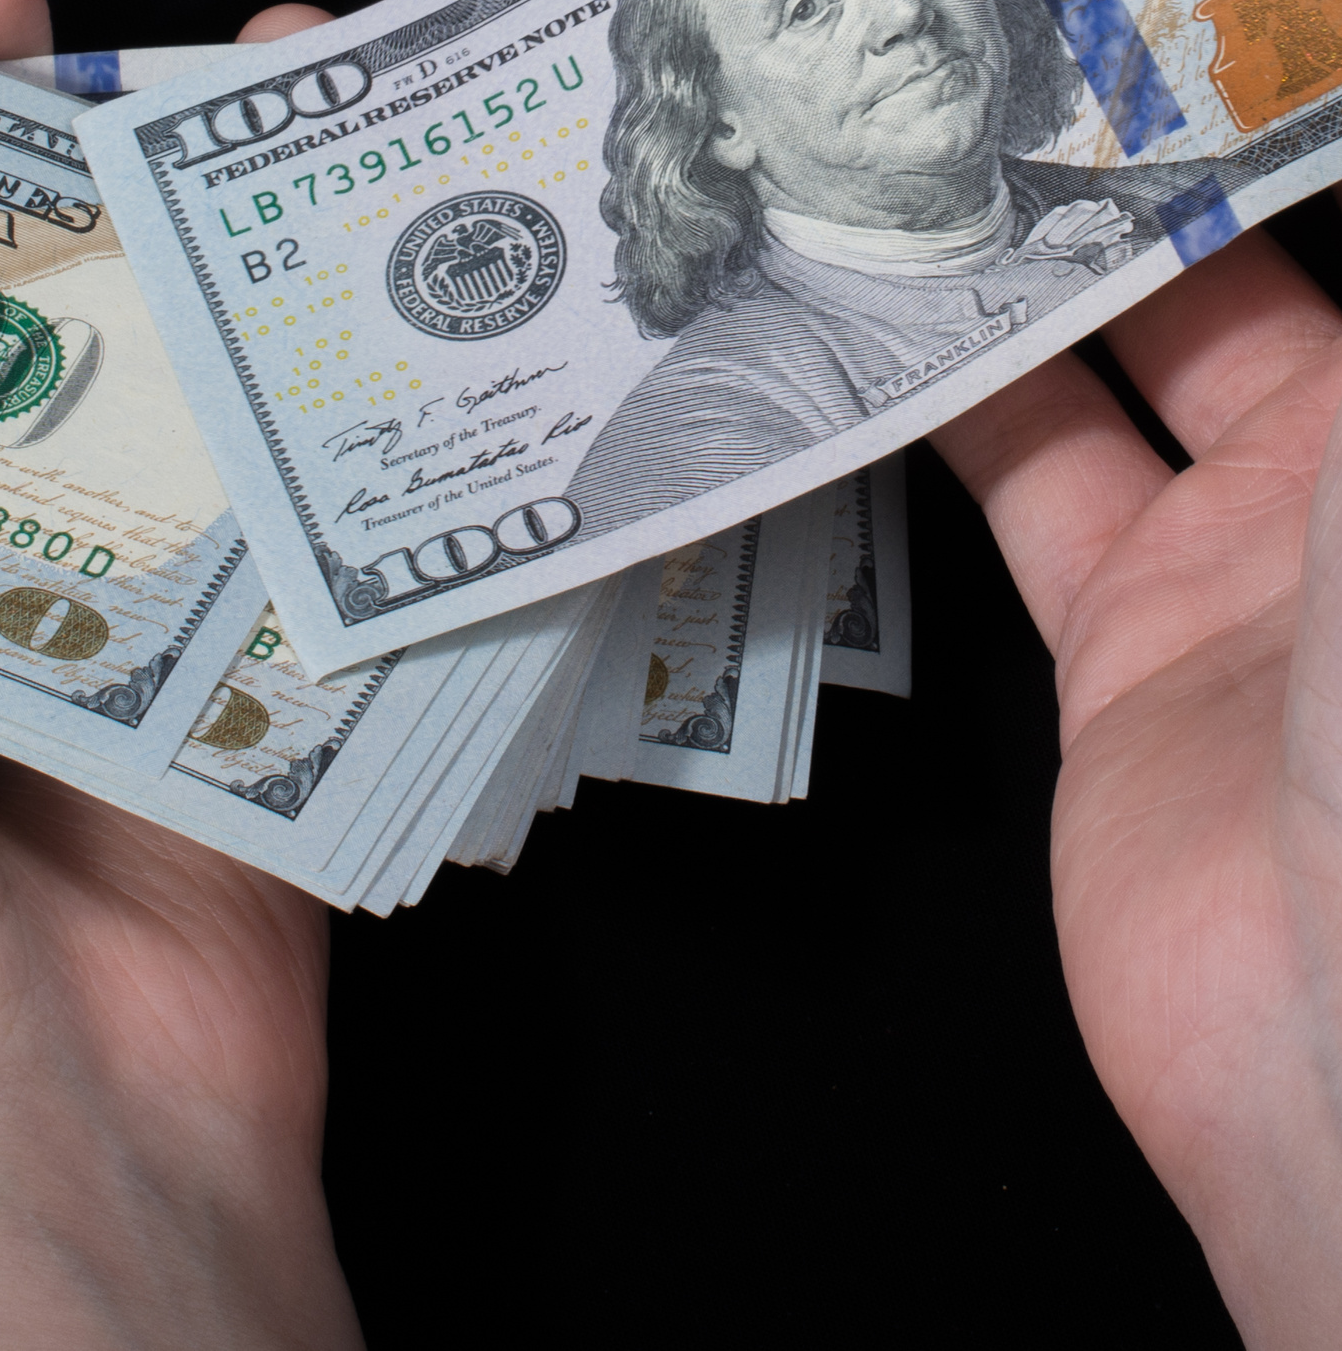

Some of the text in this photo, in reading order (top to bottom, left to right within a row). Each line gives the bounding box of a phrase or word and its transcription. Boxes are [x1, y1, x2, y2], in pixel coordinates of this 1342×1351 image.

[393, 47, 472, 90] FW D 616
[163, 61, 372, 170] 100
[200, 120, 361, 190] FEDERAL
[358, 43, 519, 128] RESERVE
[219, 54, 584, 238] LB 73916152 U
[399, 198, 524, 261] UNITED STATES
[396, 220, 558, 333] FEDERAL RESERVE SYSTEM
[3, 306, 28, 322] OF
[27, 324, 46, 349] THE
[2, 353, 51, 409] TREASURY
[891, 319, 1004, 393] FRANKLIN
[380, 404, 542, 471] Secretary of the Treasury.
[361, 457, 559, 532] Treasurer of the United States.
[79, 545, 115, 578] D
[360, 496, 584, 606] 100
